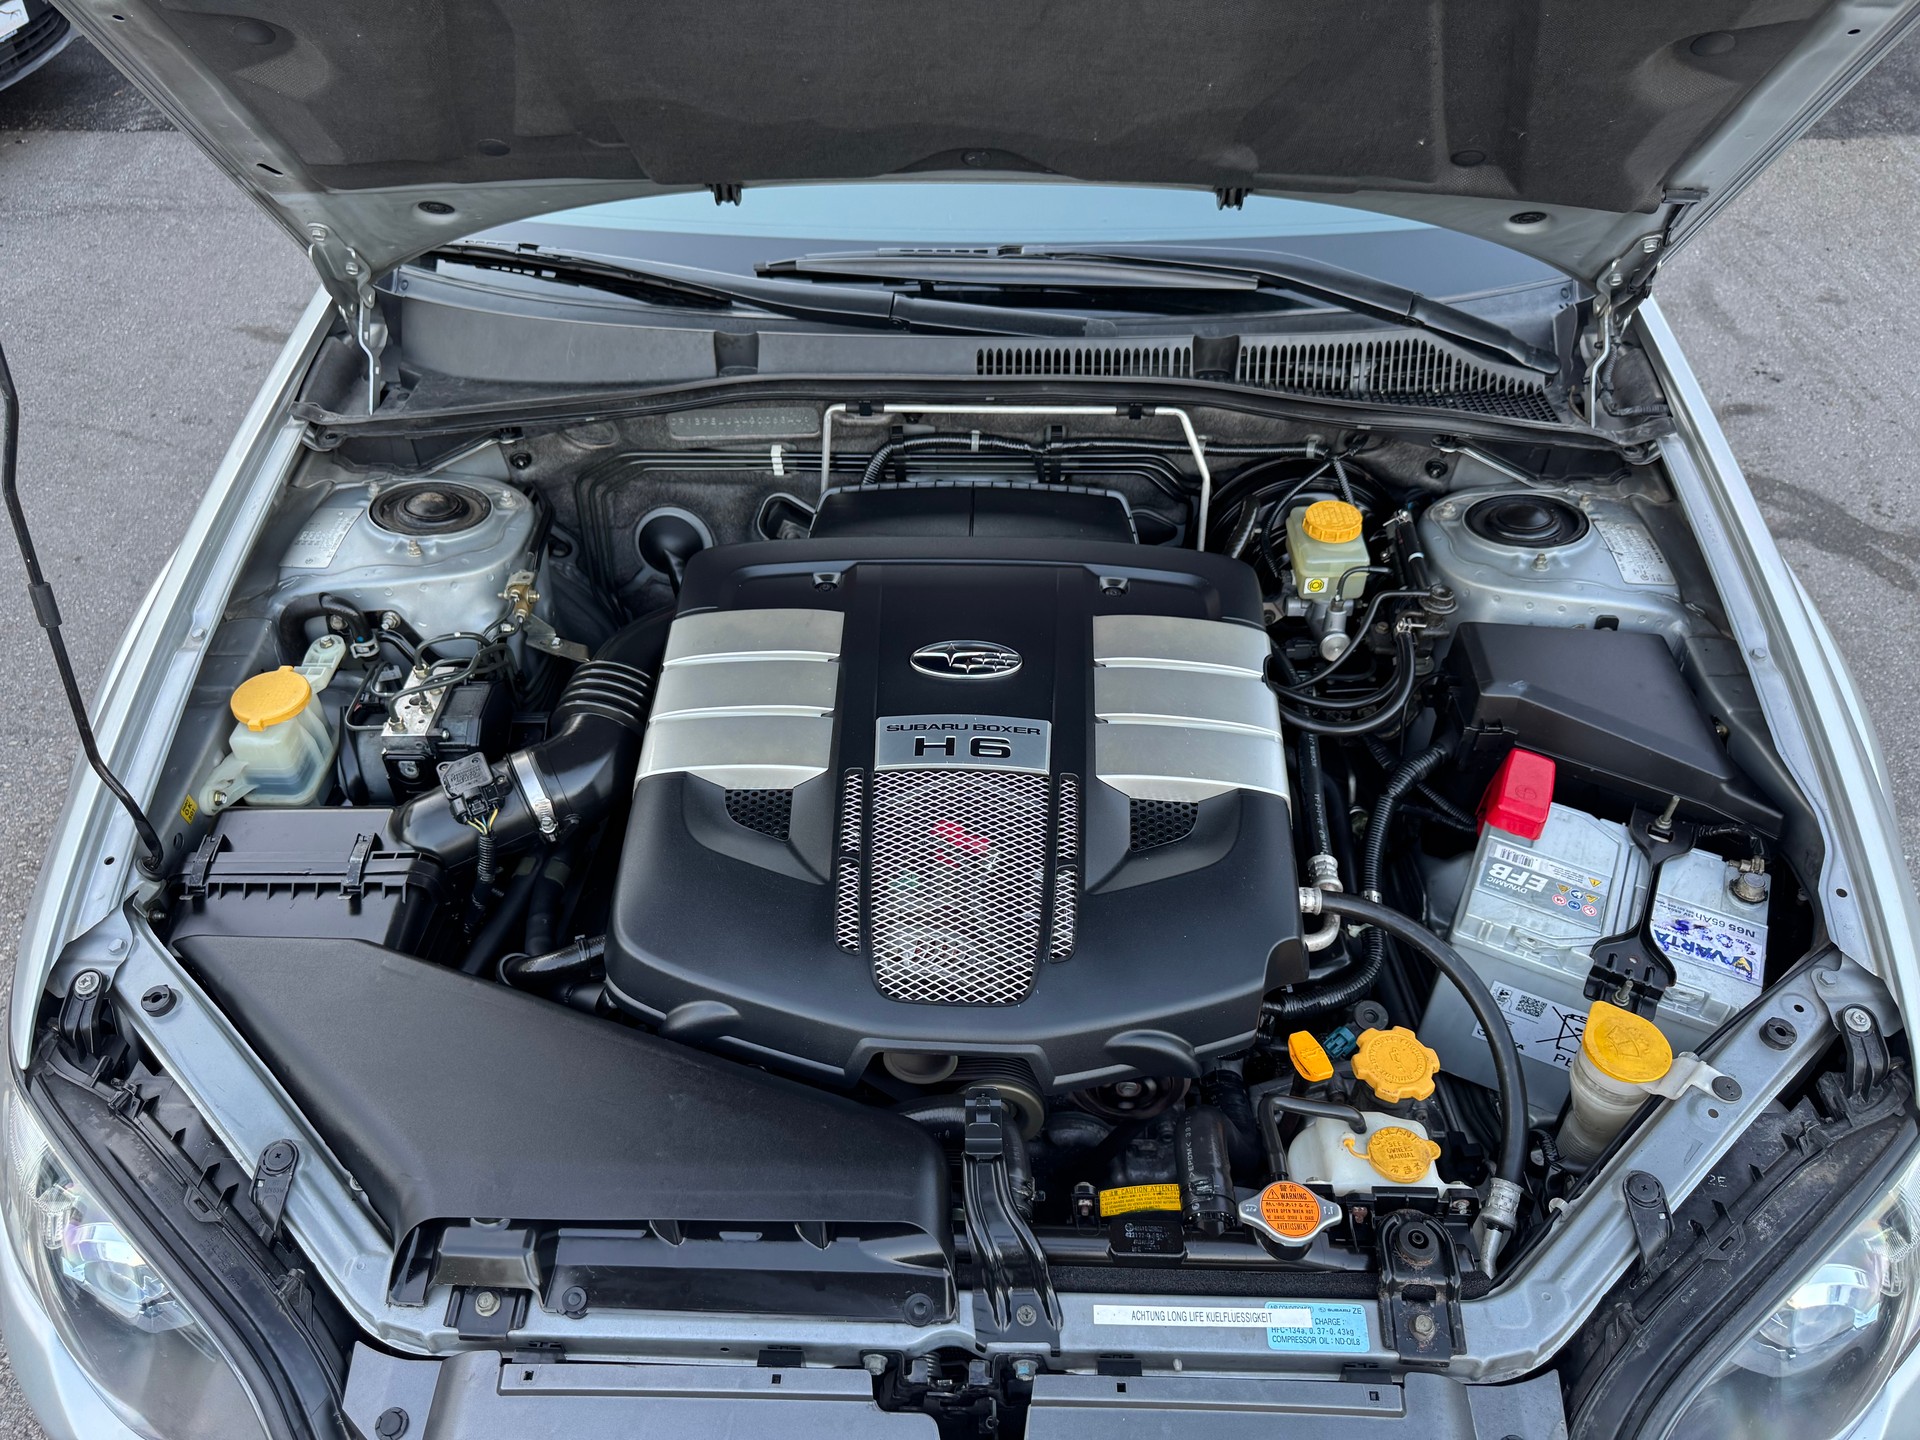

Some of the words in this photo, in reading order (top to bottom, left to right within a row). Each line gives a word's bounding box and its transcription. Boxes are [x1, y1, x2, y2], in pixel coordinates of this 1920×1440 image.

[886, 723, 968, 732] SUBARU
[972, 723, 1041, 735] BOXER
[913, 736, 1012, 758] H6
[1488, 863, 1549, 893] EFB
[1486, 876, 1528, 894] DYNAMIC
[1695, 912, 1726, 929] 65Ah
[1727, 923, 1756, 938] N65
[1653, 929, 1732, 966] VARTA
[1371, 1128, 1418, 1146] COOLANT
[1388, 1152, 1415, 1160] MANUAL
[1121, 1186, 1148, 1194] CAUTION
[1280, 1193, 1307, 1201] WARNING
[1131, 1310, 1165, 1322] ACHTUNG
[1167, 1311, 1188, 1322] LONG
[1189, 1312, 1204, 1322] LIFE
[1352, 1307, 1362, 1315] ZE
[1314, 1317, 1341, 1326] CHARGE
[1271, 1335, 1317, 1345] COMPRESSOR
[1319, 1337, 1330, 1345] OIL
